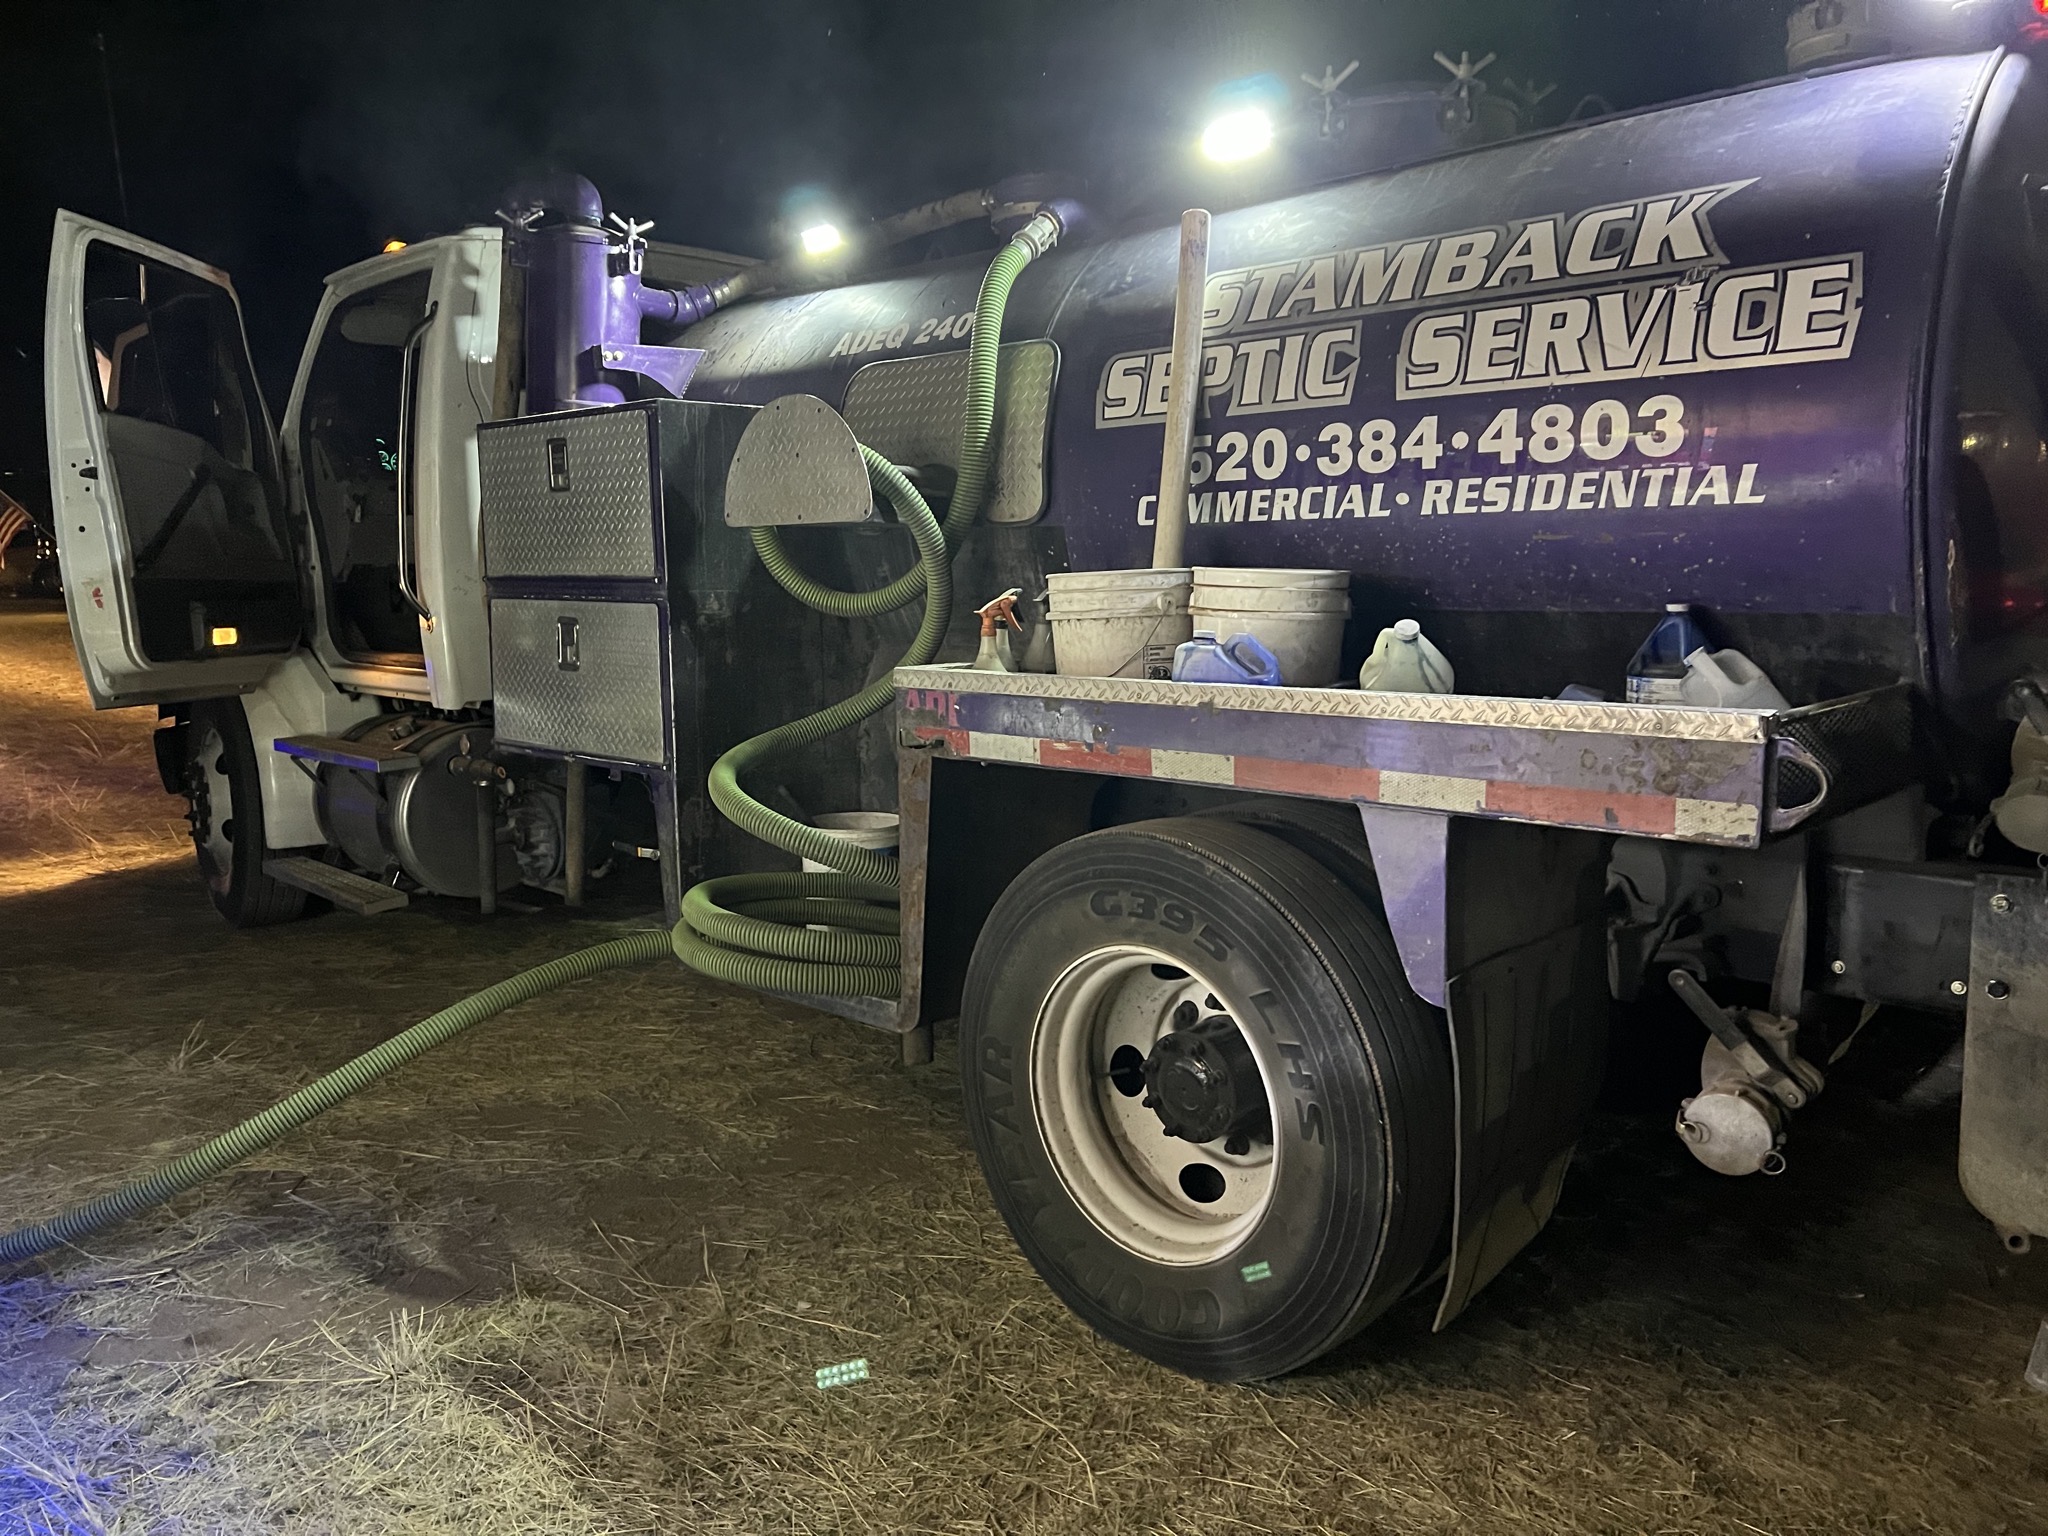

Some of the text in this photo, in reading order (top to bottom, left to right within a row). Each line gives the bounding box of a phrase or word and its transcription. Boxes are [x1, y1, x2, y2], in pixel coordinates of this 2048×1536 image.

[1202, 190, 1719, 330] STAMBACK
[829, 322, 910, 358] ADEQ
[1102, 262, 1850, 419] SEPTIC SERVICE
[1136, 463, 1767, 526] CMMERCIAL RESIDENTIAL
[1089, 888, 1235, 963] G395
